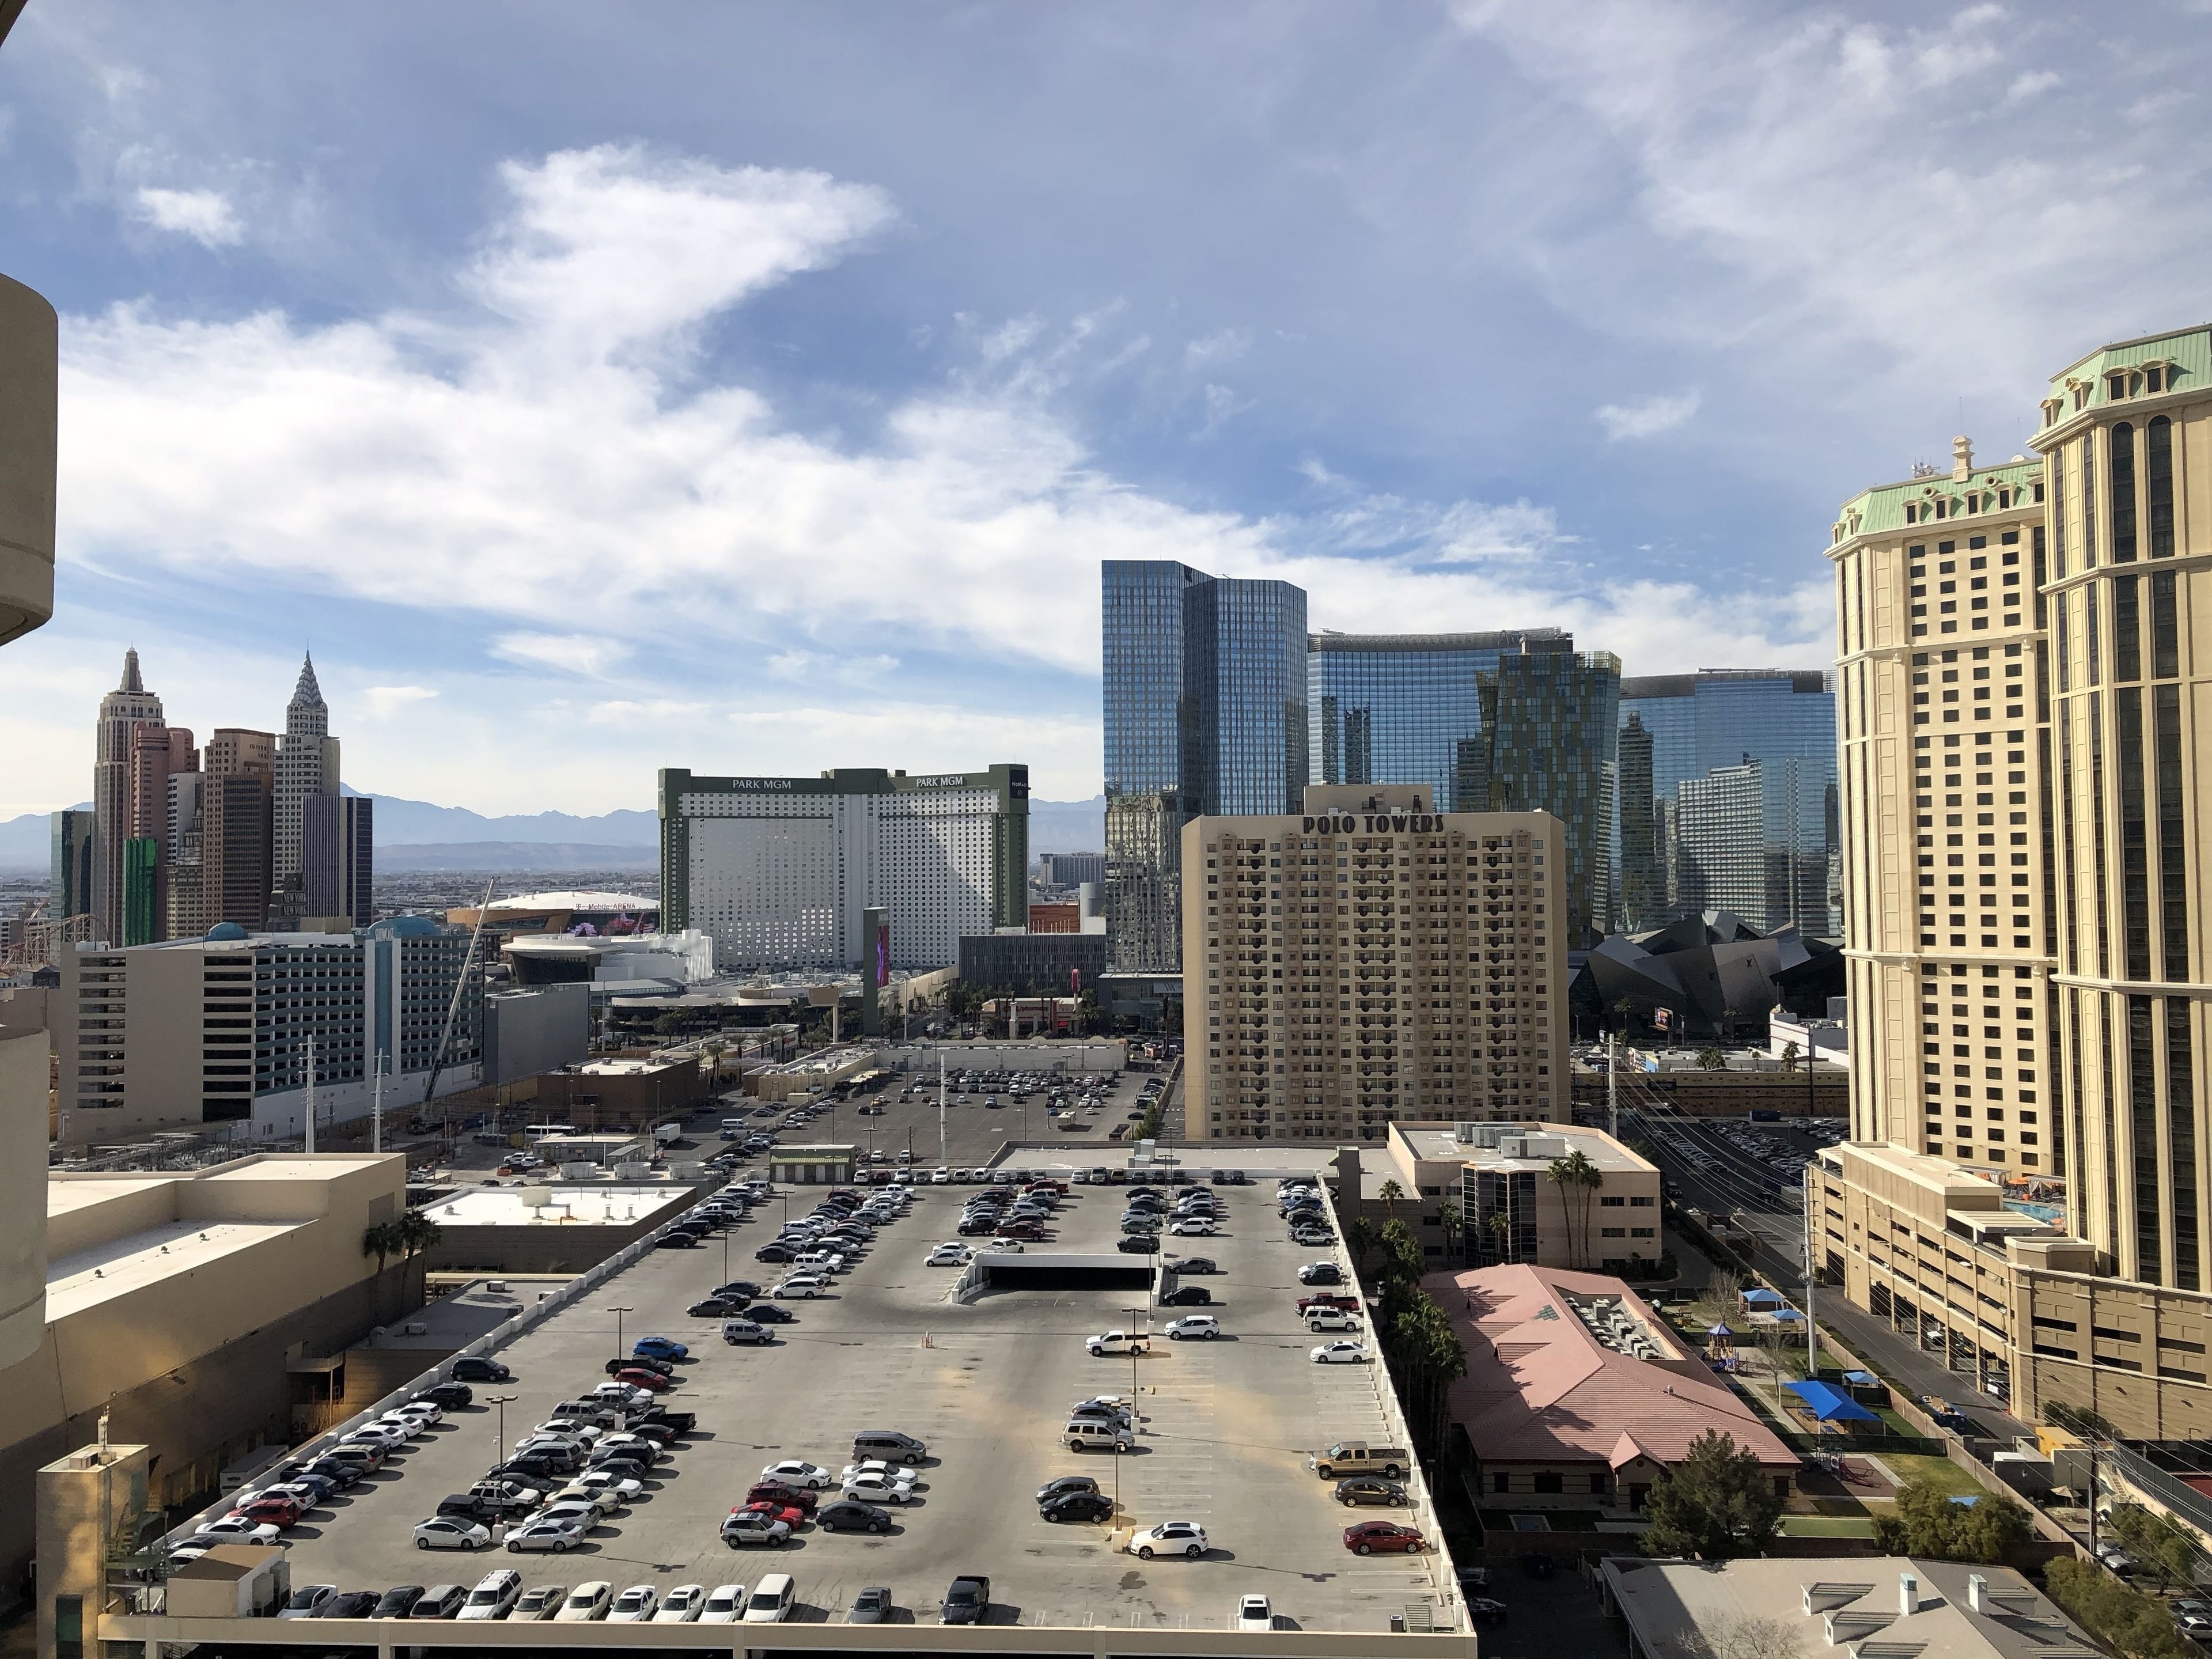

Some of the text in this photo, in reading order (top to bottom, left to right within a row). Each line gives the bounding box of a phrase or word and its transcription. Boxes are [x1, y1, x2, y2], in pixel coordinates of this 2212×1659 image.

[733, 779, 791, 789] PARK MGM
[916, 776, 963, 787] PARK MGM
[1303, 815, 1444, 834] POLO TOWERS
[284, 893, 306, 903] NEW YORK
[284, 906, 294, 915] NEW
